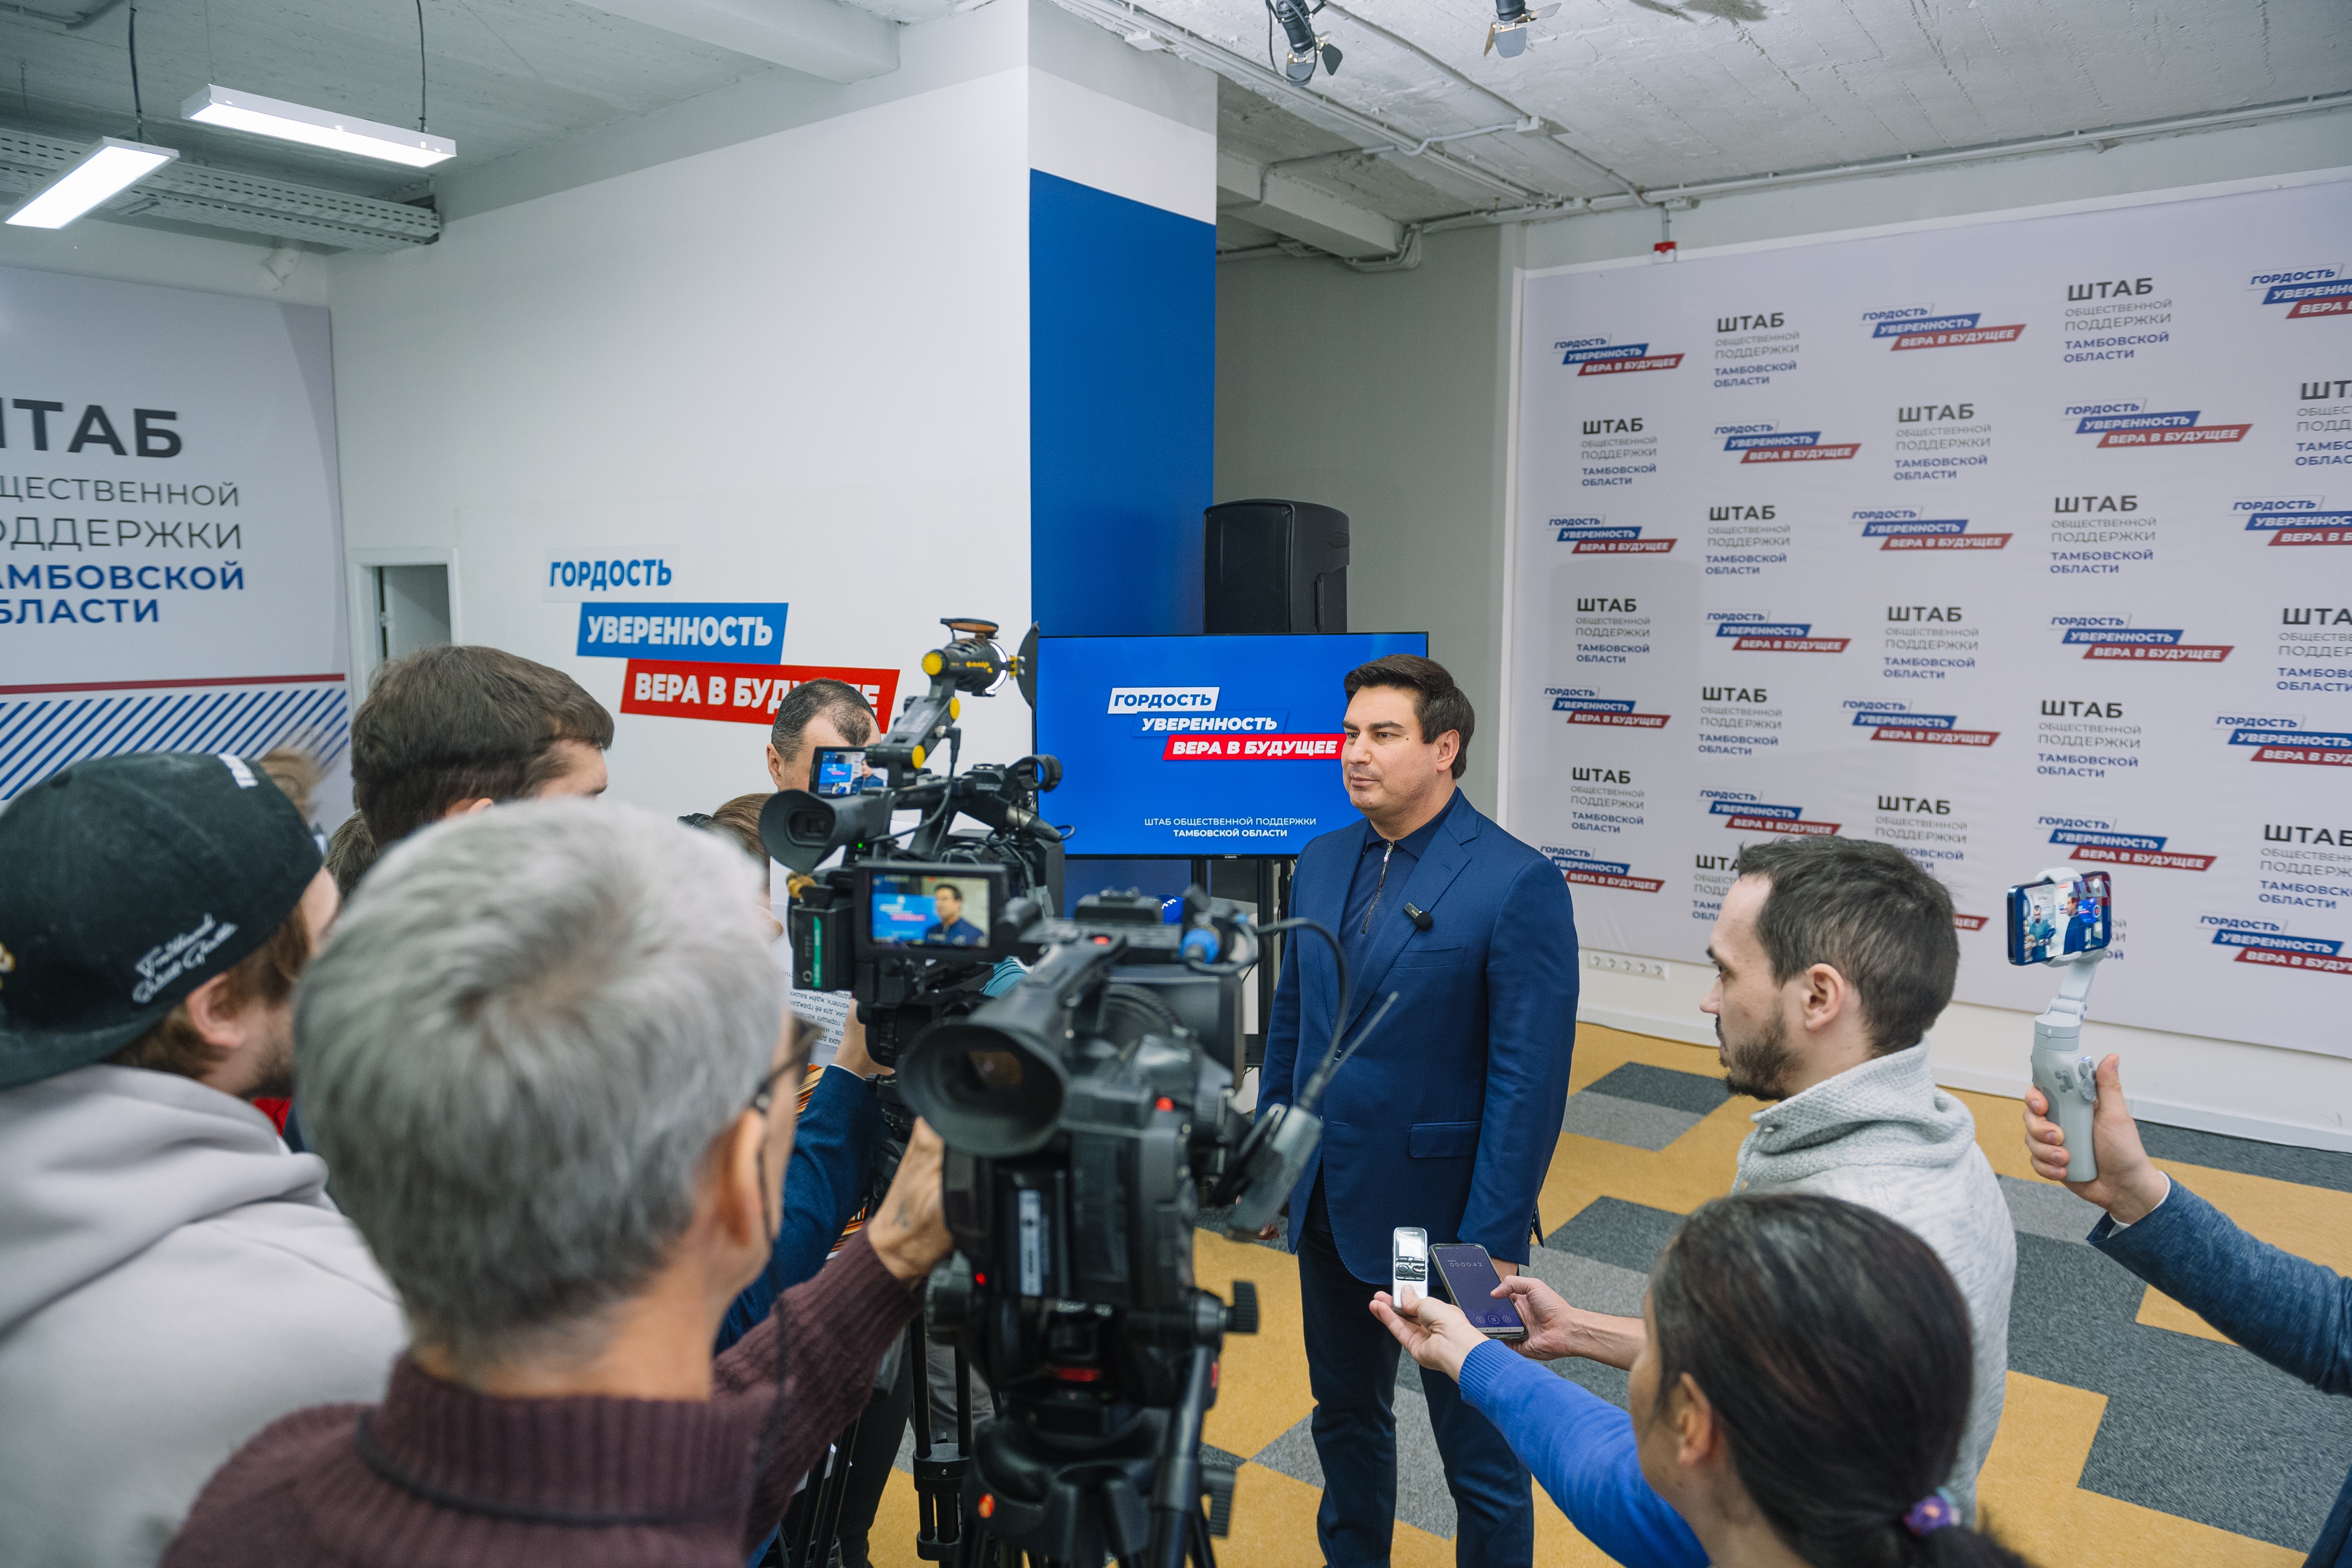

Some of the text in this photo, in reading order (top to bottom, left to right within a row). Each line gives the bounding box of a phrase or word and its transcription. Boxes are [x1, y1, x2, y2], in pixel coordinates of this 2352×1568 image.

[2252, 269, 2334, 284] ГОРДОСТЬ
[2068, 277, 2152, 301] ШТАБ
[2301, 301, 2342, 313] ВЕРА
[1718, 312, 1784, 332] ШТАБ
[1555, 337, 1606, 349] ГОРДОСТЬ
[2064, 331, 2169, 350] ТАМБОВСКОЙ
[1569, 347, 1642, 362] УВЕРЕННОСТЬ
[2063, 349, 2134, 363] ОБЛАСТИ
[1586, 363, 1611, 372] ВЕРА
[1625, 357, 1676, 370] БУДУЩЕЕ
[1714, 359, 1796, 376] ТАМБОВСКОЙ
[1714, 375, 1769, 387] ОБЛАСТИ
[1899, 403, 1974, 422] ШТАБ
[2065, 403, 2139, 416] ГОРДОСТЬ
[0, 397, 182, 458] ТАБ
[1583, 417, 1643, 434] ШТАБ
[2084, 415, 2191, 430] УВЕРЕННОСТЬ
[1715, 424, 1773, 435] ГОРДОСТЬ
[1730, 435, 1814, 448] УВЕРЕННОСТЬ
[2109, 429, 2239, 444] ВЕРА В БУДУЩЕЕ
[1750, 451, 1779, 460] ВЕРА
[1793, 447, 1852, 459] БУДУЩЕЕ
[2295, 454, 2352, 465] ОБЛАС
[1894, 453, 1987, 468] ТАМБОВСКОЙ
[1582, 463, 1657, 475] ТАМБОВСКОЙ
[1894, 470, 1956, 480] ОБЛАСТИ
[1582, 477, 1632, 486] ОБЛАСТИ
[0, 475, 240, 507] ЩЕСТВЕННОЙ
[2055, 495, 2138, 512] ШТАБ
[2234, 500, 2315, 512] ГОРДОСТЬ
[1710, 505, 1775, 521] ШТАБ
[1852, 510, 1917, 521] ГОРДОСТЬ
[1550, 518, 1599, 527] ГОРДОСТЬ
[2255, 515, 2352, 527] УВЕРЕННОС
[0, 516, 242, 552] ДДЕРЖКИ
[1563, 529, 1635, 539] УВЕРЕННОСТЬ
[1870, 523, 1961, 534] УВЕРЕННОСТЬ
[1890, 538, 1923, 547] ВЕРА
[1938, 537, 2002, 548] БУДУЩЕЕ
[2281, 533, 2323, 542] ВЕРА
[2327, 532, 2340, 541] В
[1618, 542, 1669, 552] БУДУЩЕЕ
[1706, 552, 1786, 562] ТАМБОВСКОЙ
[2051, 549, 2153, 560] ТАМБОВСКОЙ
[2050, 564, 2119, 573] ОБЛАСТИ
[0, 561, 245, 590] МБОВСКОЙ
[549, 559, 673, 592] ГОРДОСТЬ
[1577, 598, 1636, 611] ШТАБ
[1707, 613, 1764, 622] ГОРДОСТЬ
[1888, 606, 1962, 622] ШТАБ
[2283, 608, 2351, 625] ШТА
[2051, 617, 2124, 627] ГОРДОСТЬ
[586, 615, 774, 647] УВЕРЕННОСТЬ
[1723, 626, 1804, 636] УВЕРЕННОСТЬ
[2070, 632, 2175, 643] УВЕРЕННОСТЬ
[1576, 644, 1650, 653] ТАМБОВСКОЙ
[1742, 639, 1770, 648] ВЕРА
[1784, 641, 1842, 651] БУДУЩЕЕ
[1576, 654, 1625, 663] ОБЛАСТИ
[2094, 647, 2222, 660] ВЕРА В БУДУЩЕЕ
[1884, 657, 1975, 667] ТАМБОВСКОЙ
[1884, 669, 1945, 679] ОБЛАСТИ
[635, 672, 880, 716] ВЕРА В БУДЕ
[1545, 688, 1594, 697] ГОРДОСТЬ
[1703, 686, 1767, 702] ШТАБ
[1114, 693, 1212, 709] ГОРДОСТЬ
[1559, 700, 1629, 712] УВЕРЕННОСТЬ
[2041, 700, 2123, 718] ШТАБ
[1142, 717, 1278, 731] УВЕРЕННОСТЬ
[1575, 714, 1600, 722] ВЕРА
[1613, 716, 1662, 726] БУДУЩЕЕ
[2217, 716, 2297, 728] ГОРДОСТЬ
[1699, 733, 1777, 746] ТАМБОВСКОЙ
[2238, 732, 2352, 748] УВЕРЕННОСТЬ
[1172, 740, 1338, 756] ВЕРА В БУДУЩЕЕ
[1699, 744, 1751, 755] ОБЛАСТИ
[2037, 753, 2138, 767] ТАМБОВСКОЙ
[2264, 749, 2304, 760] ВЕРА
[2309, 752, 2320, 761] В
[1573, 767, 1630, 784] ШТАБ
[2037, 765, 2104, 778] ОБЛАСТИ
[1700, 790, 1756, 801] ГОРДОСТЬ
[1716, 803, 1795, 819] УВЕРЕННОСТЬ
[1878, 796, 1950, 815] ШТАБ
[1173, 817, 1253, 826] ОБЩЕСТВЕННОЙ
[1255, 818, 1316, 826] ПОДДЕРЖКИ
[1572, 812, 1643, 824] ТАМБОВСКОЙ
[2038, 816, 2110, 829] ГОРДОСТЬ
[1173, 828, 1240, 837] ТАМБОВСКОЙ
[1571, 822, 1620, 833] ОБЛАСТИ
[1734, 818, 1762, 828] ВЕРА
[1777, 822, 1832, 835] БУДУЩЕЕ
[2056, 831, 2159, 850] УВЕРЕННОСТЬ
[1541, 845, 1589, 857] ГОРДОСТЬ
[1901, 847, 1964, 861] БОВСКОЙ
[2080, 849, 2205, 868] ВЕРА В БУДУЩЕЕ
[1571, 873, 1595, 882] ВЕРА
[1608, 877, 1656, 890] БУДУЩЕЕ
[2260, 880, 2352, 897] ТАМБОВСК
[2259, 892, 2335, 909] ОБЛАСТИ
[2201, 915, 2279, 931] ГОРДОСТЬ
[2221, 932, 2333, 954] УВЕРЕННОСТЬ
[2246, 951, 2302, 965] ВЕРА В
